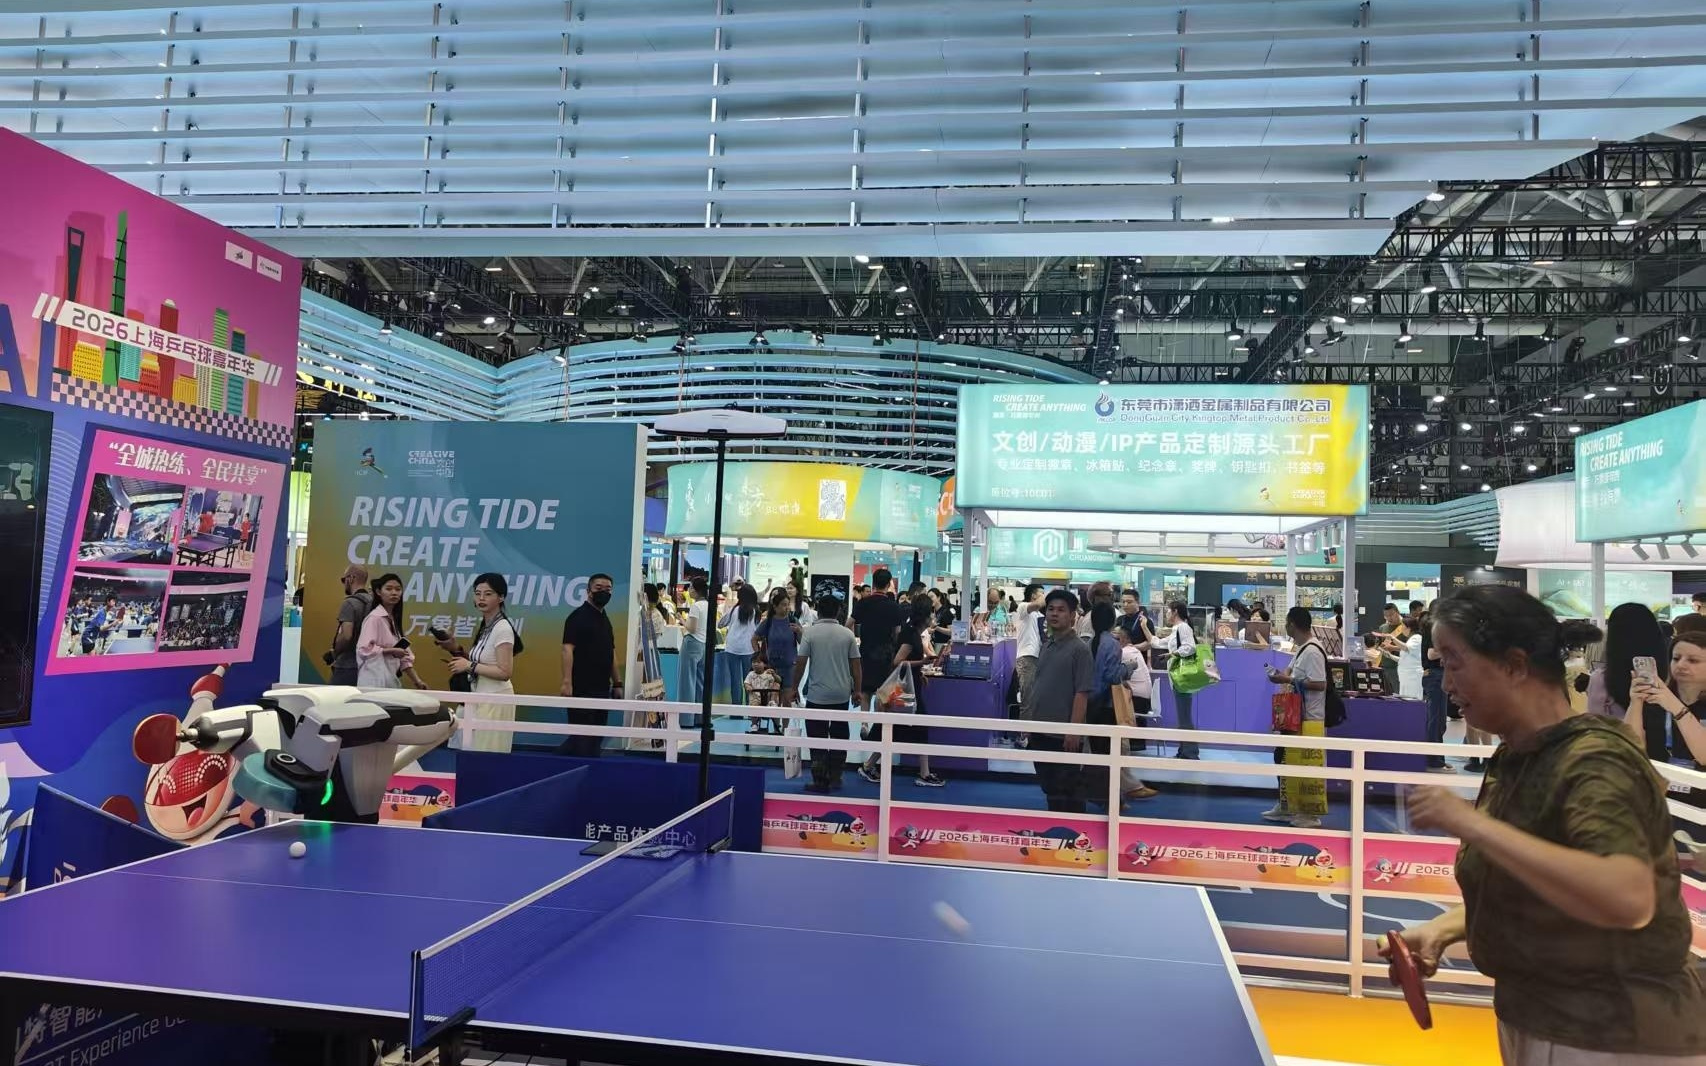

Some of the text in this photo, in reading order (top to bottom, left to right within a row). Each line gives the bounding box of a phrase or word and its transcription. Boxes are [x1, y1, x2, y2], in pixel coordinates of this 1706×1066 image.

[71, 307, 255, 376] 2026上海乒乓球嘉年华
[1006, 403, 1087, 411] CREATE ANYTHING
[1121, 398, 1331, 412] 东莞市潇洒金属制品有限公司
[1230, 414, 1257, 422] Metal
[1259, 414, 1294, 422] Product
[992, 431, 1331, 455] 文创/动漫/IP产品定制源头工厂
[1580, 431, 1623, 456] RISING TIDE
[1590, 439, 1664, 471] CREATE ANYTHING
[350, 496, 559, 530] RISING TIDE
[347, 535, 480, 568] CREATE
[402, 572, 590, 607] ANYHING
[405, 614, 524, 637] 万象皆
[939, 831, 1052, 848] 2026上海乒乓球嘉年华
[1171, 848, 1292, 866] 2026上海乒乓球嘉年华
[1416, 864, 1454, 877] 2026
